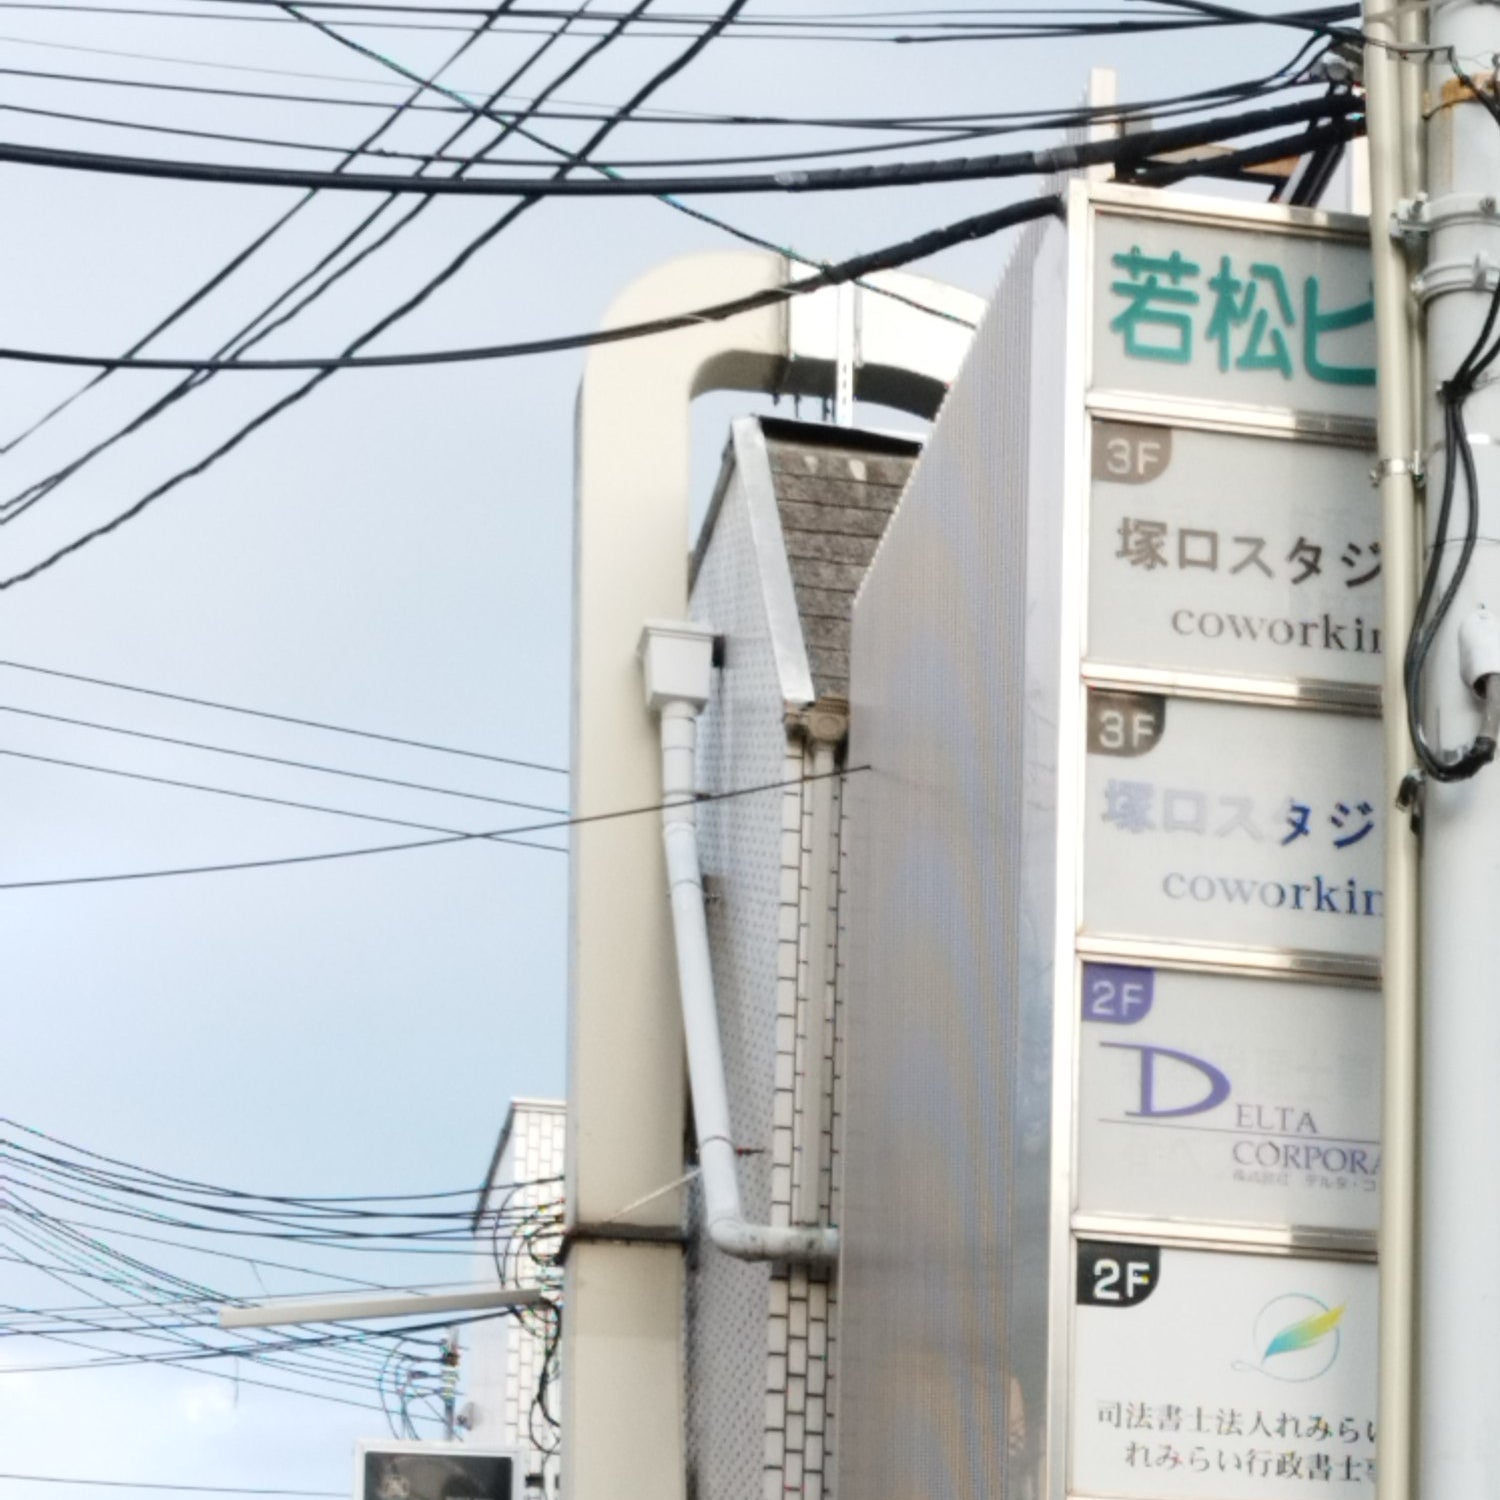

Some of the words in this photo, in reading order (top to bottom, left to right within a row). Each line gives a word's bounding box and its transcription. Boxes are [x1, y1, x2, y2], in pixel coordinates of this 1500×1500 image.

[1106, 438, 1161, 476] 3F
[1099, 709, 1155, 750] 3F
[1091, 980, 1143, 1016] 2F
[1093, 1258, 1150, 1300] 2F
